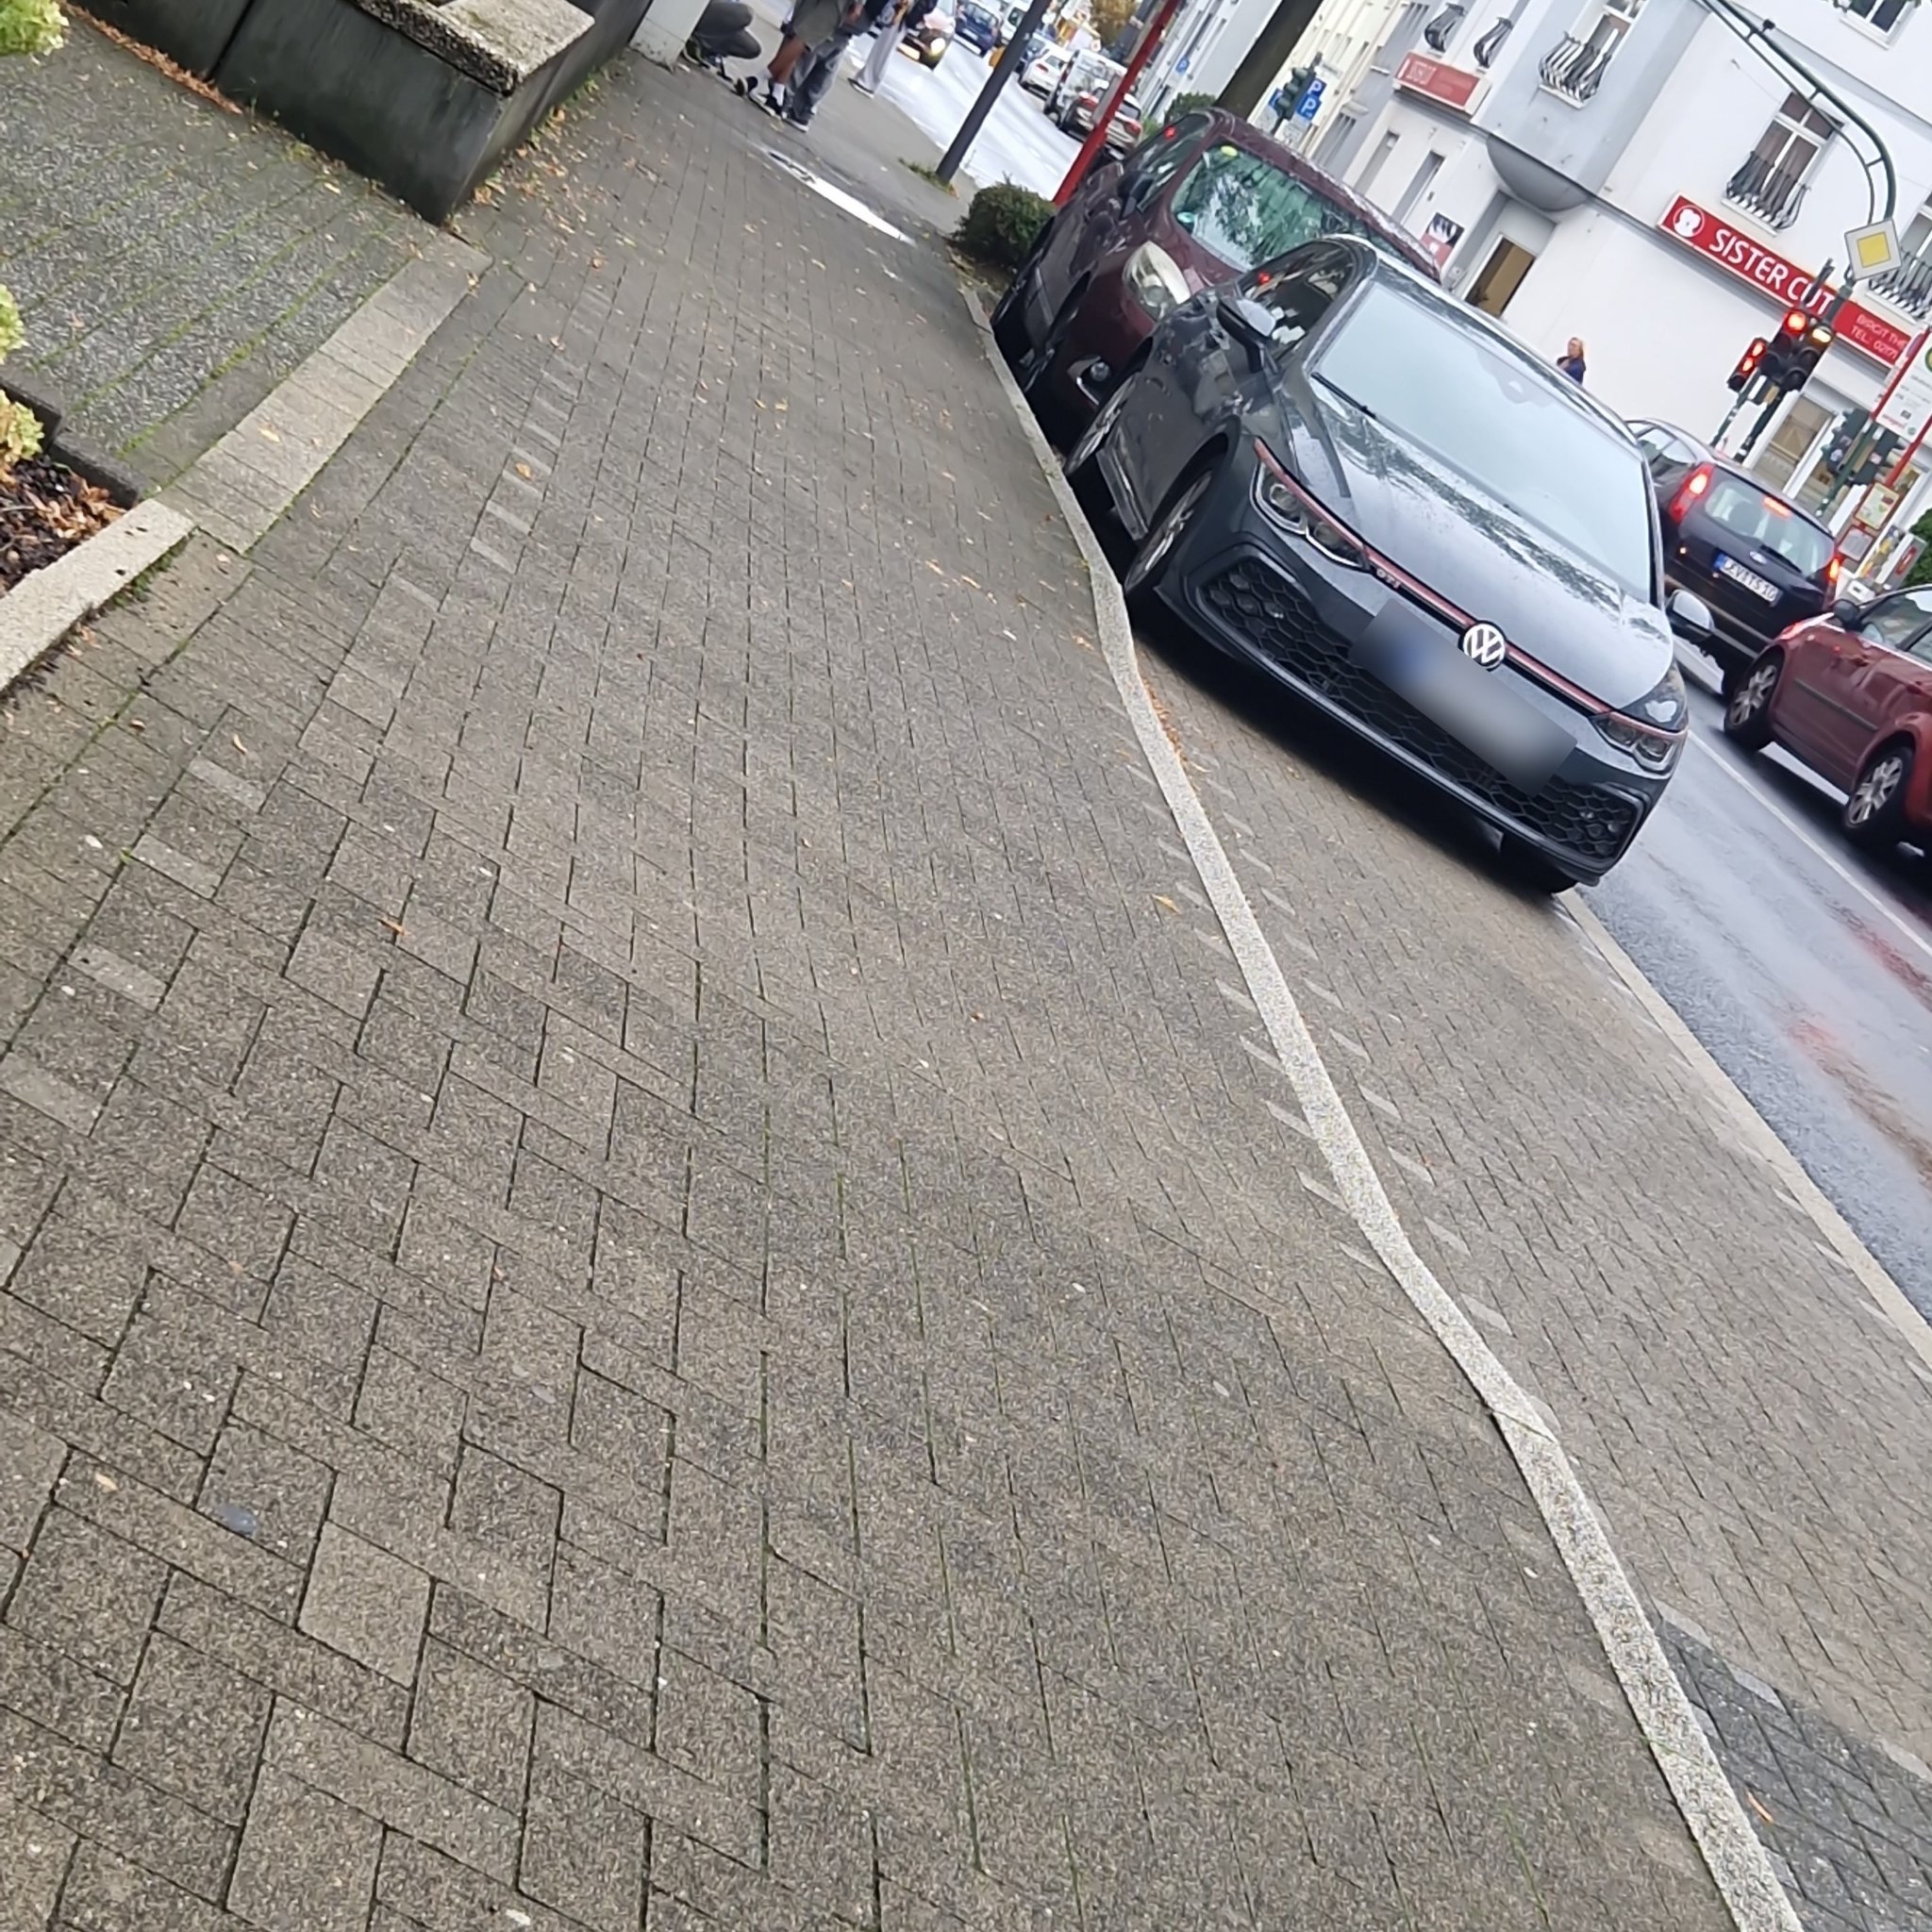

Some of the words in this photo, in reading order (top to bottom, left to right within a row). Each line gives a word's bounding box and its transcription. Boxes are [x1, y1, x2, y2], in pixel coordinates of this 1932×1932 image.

[1307, 80, 1323, 94] P
[1301, 97, 1317, 113] P
[1708, 228, 1789, 290] SISTER
[1787, 276, 1836, 315] CUT
[1376, 568, 1401, 589] GTI
